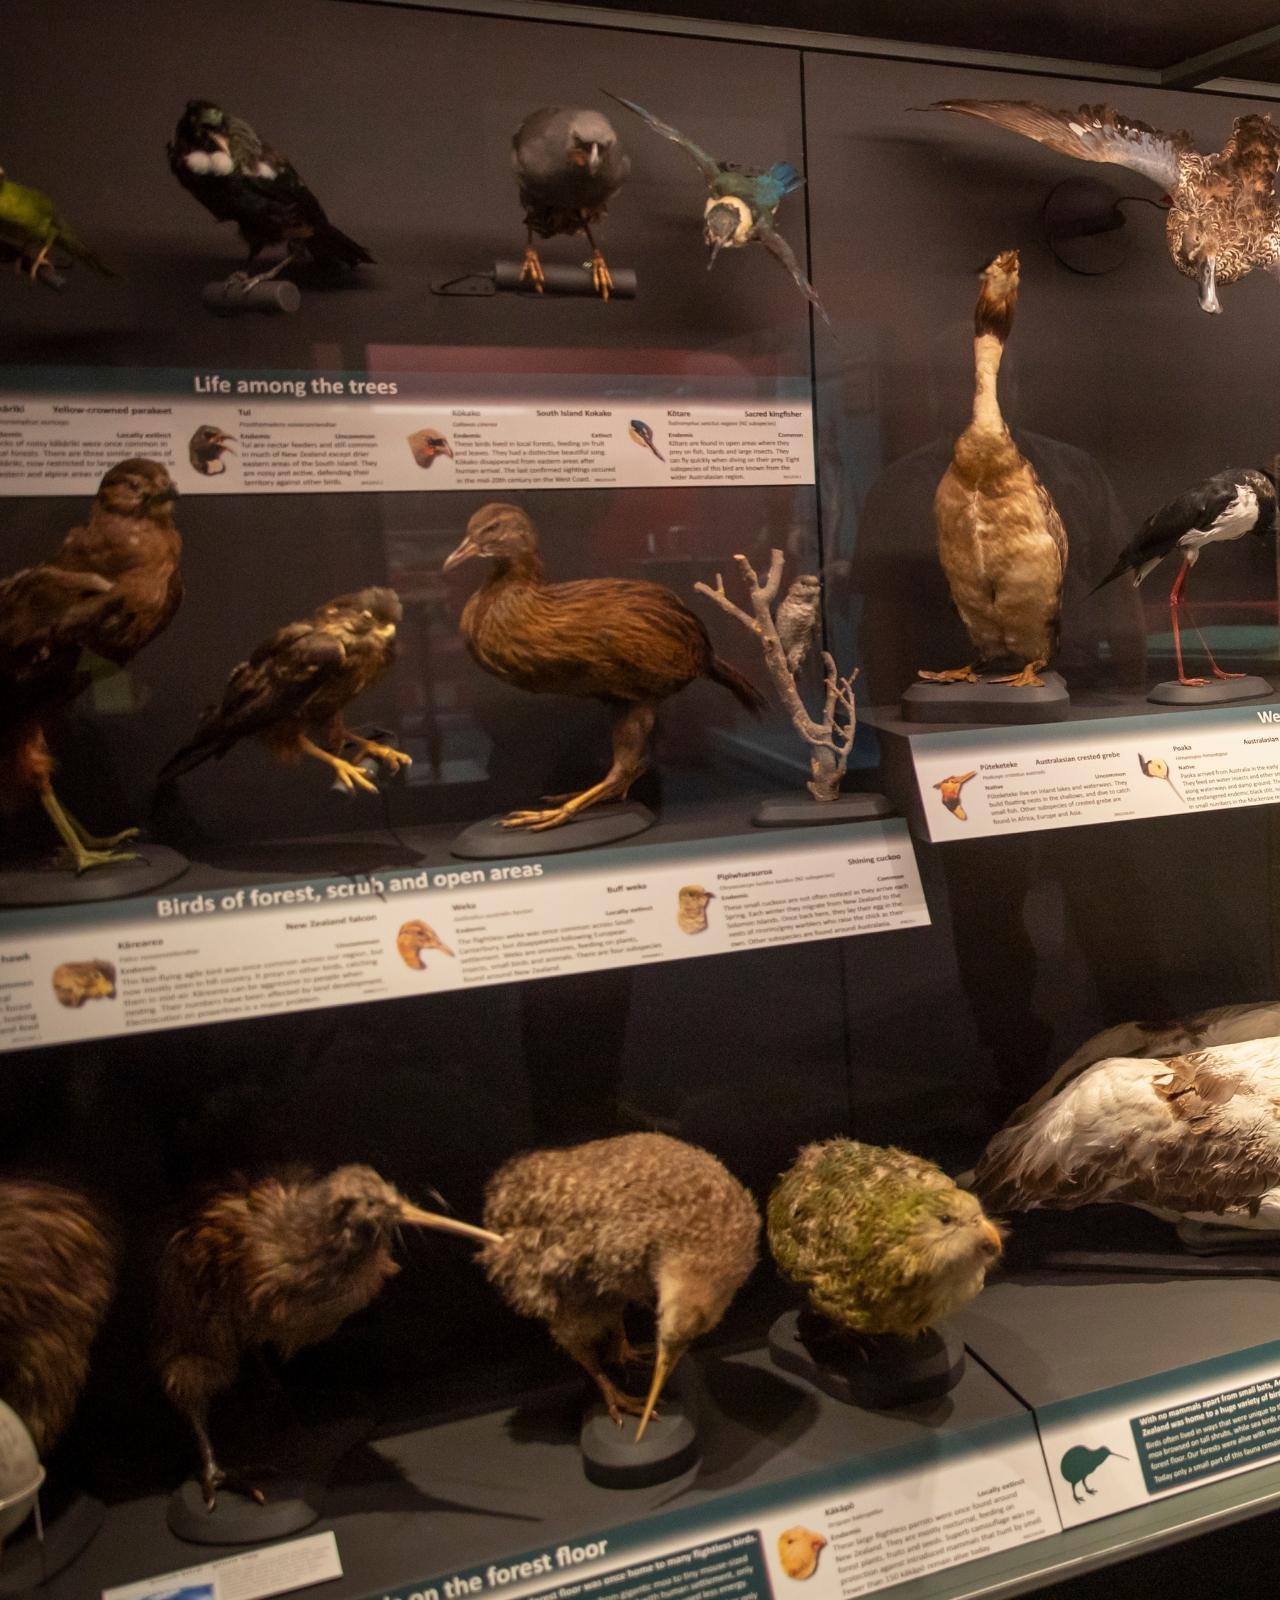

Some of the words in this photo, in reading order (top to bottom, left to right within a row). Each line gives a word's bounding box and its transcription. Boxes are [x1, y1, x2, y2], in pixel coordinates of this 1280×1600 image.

[194, 377, 230, 393] Life
[237, 381, 305, 398] among
[312, 379, 343, 394] the
[349, 380, 398, 395] trees
[768, 410, 802, 419] kingfisher
[1035, 756, 1075, 765] Australasian
[1077, 753, 1100, 761] crested
[1102, 751, 1121, 761] grebe
[847, 856, 874, 865] Shining
[876, 854, 901, 862] cuckoo
[156, 896, 214, 916] Birds
[221, 891, 243, 909] of
[250, 885, 321, 906] forest,
[327, 876, 383, 898] scrub
[389, 871, 427, 891] and
[433, 868, 484, 889] open
[490, 862, 544, 880] areas
[452, 902, 476, 910] Weka
[1139, 1413, 1156, 1425] With
[1168, 1402, 1201, 1417] mammals
[1202, 1396, 1219, 1409] apart
[1221, 1393, 1237, 1403] from
[1238, 1386, 1255, 1398] small
[1256, 1383, 1273, 1393] bats,
[1142, 1421, 1169, 1436] Zealand
[1170, 1419, 1184, 1428] was
[1185, 1413, 1204, 1424] home
[1219, 1404, 1236, 1414] huge
[1237, 1397, 1260, 1409] variety
[444, 1574, 481, 1598] the
[488, 1553, 550, 1586] forest
[556, 1539, 608, 1567] floor
